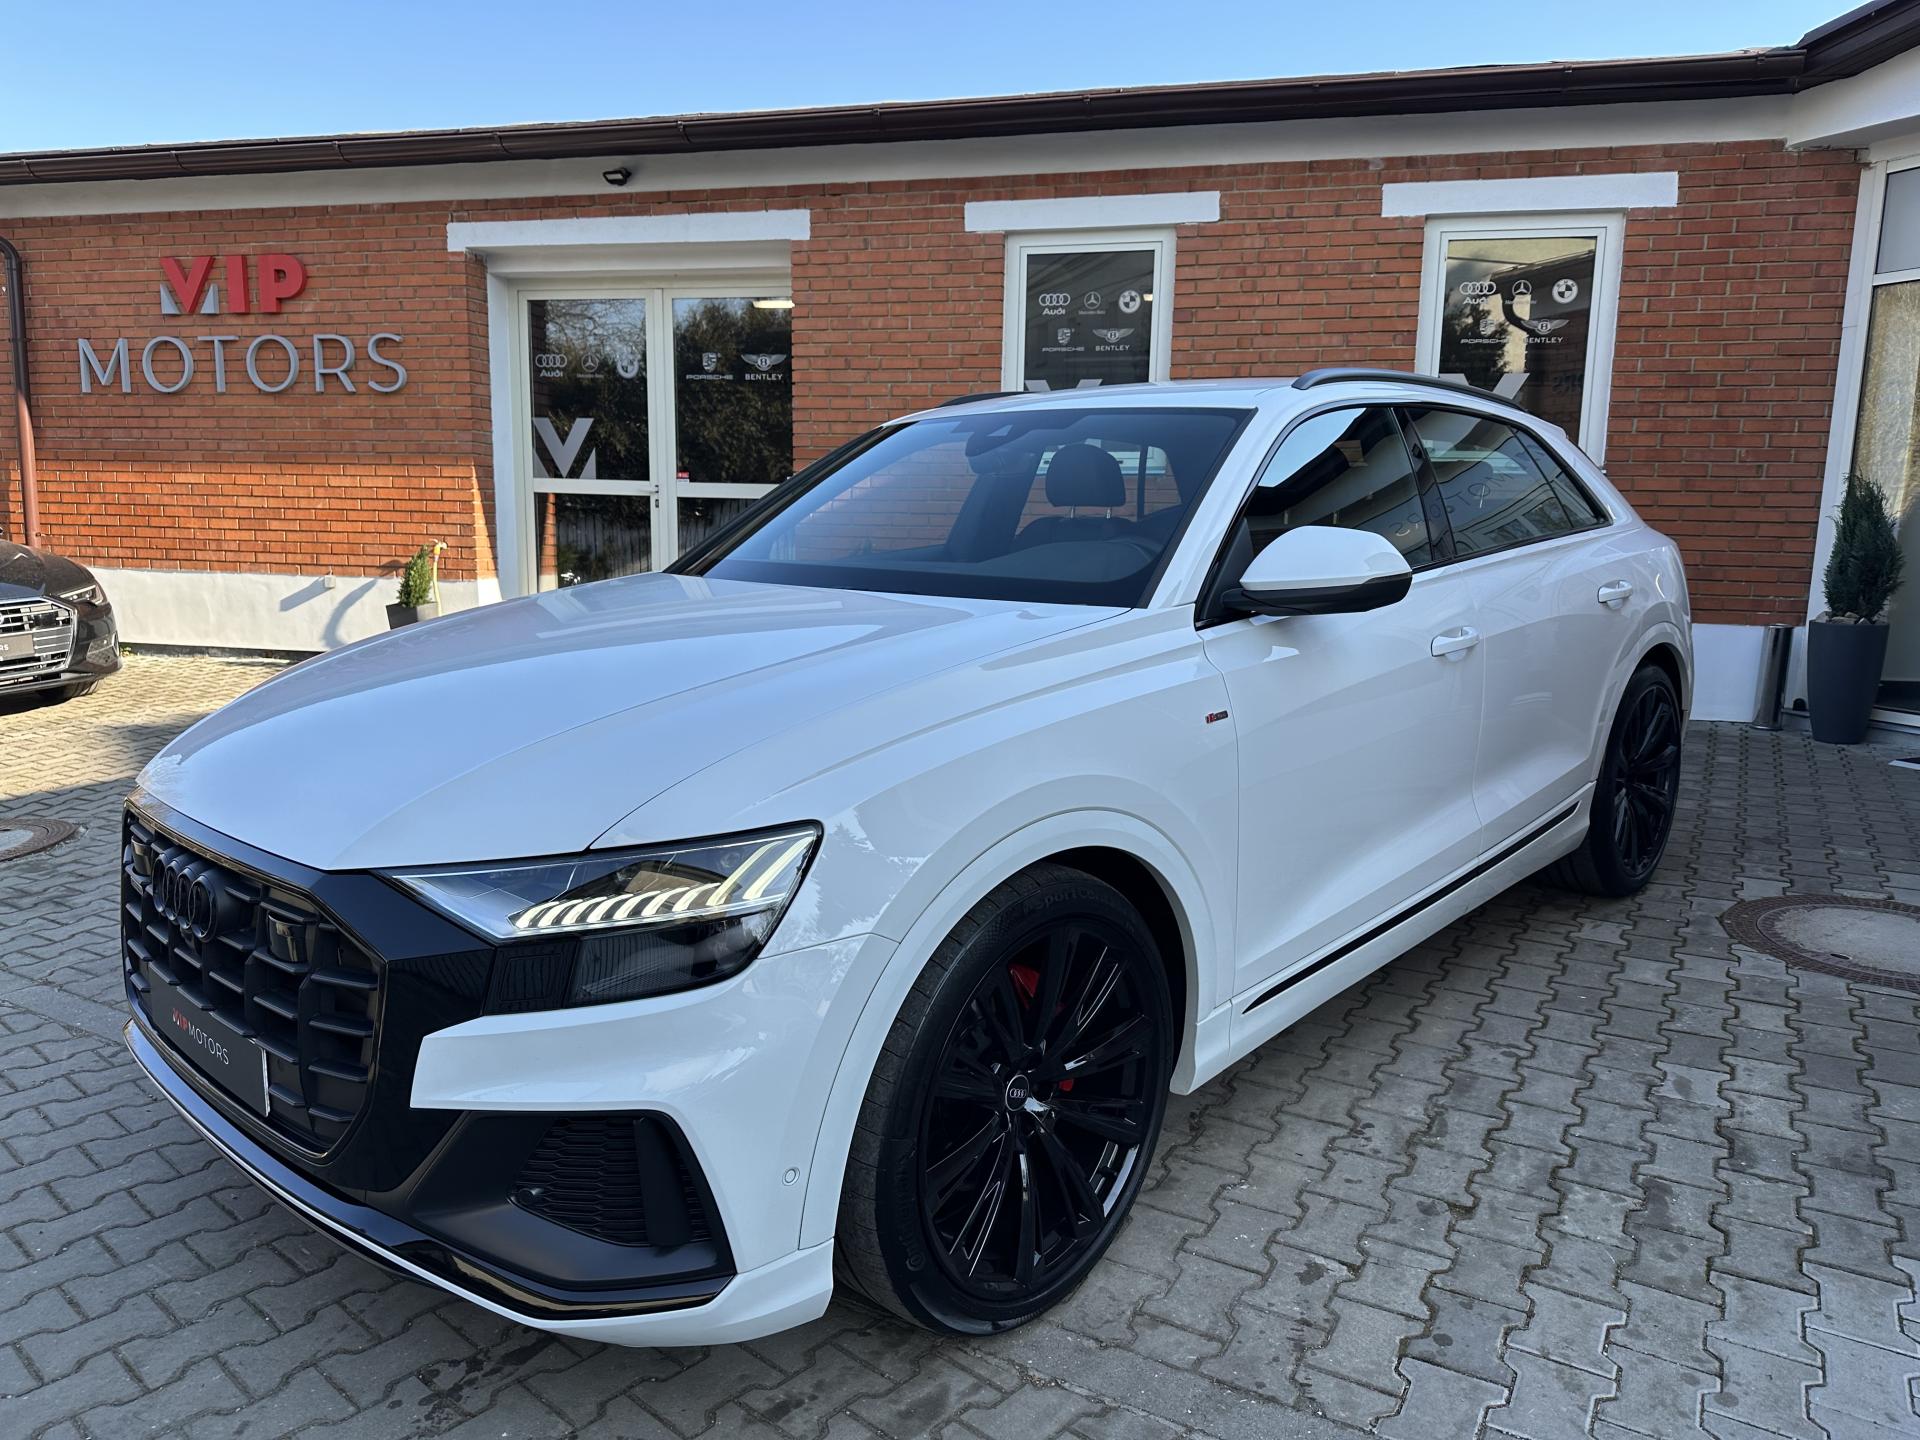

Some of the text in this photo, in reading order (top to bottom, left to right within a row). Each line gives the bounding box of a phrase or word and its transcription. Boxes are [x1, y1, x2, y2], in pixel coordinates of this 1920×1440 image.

[160, 254, 307, 316] VIP
[1463, 297, 1491, 305] Aud
[1042, 308, 1066, 316] Audi
[1095, 344, 1130, 352] BENTLEY
[78, 333, 408, 395] MOTORS
[744, 373, 783, 381] BENTLEY
[188, 1021, 229, 1065] MOTORS
